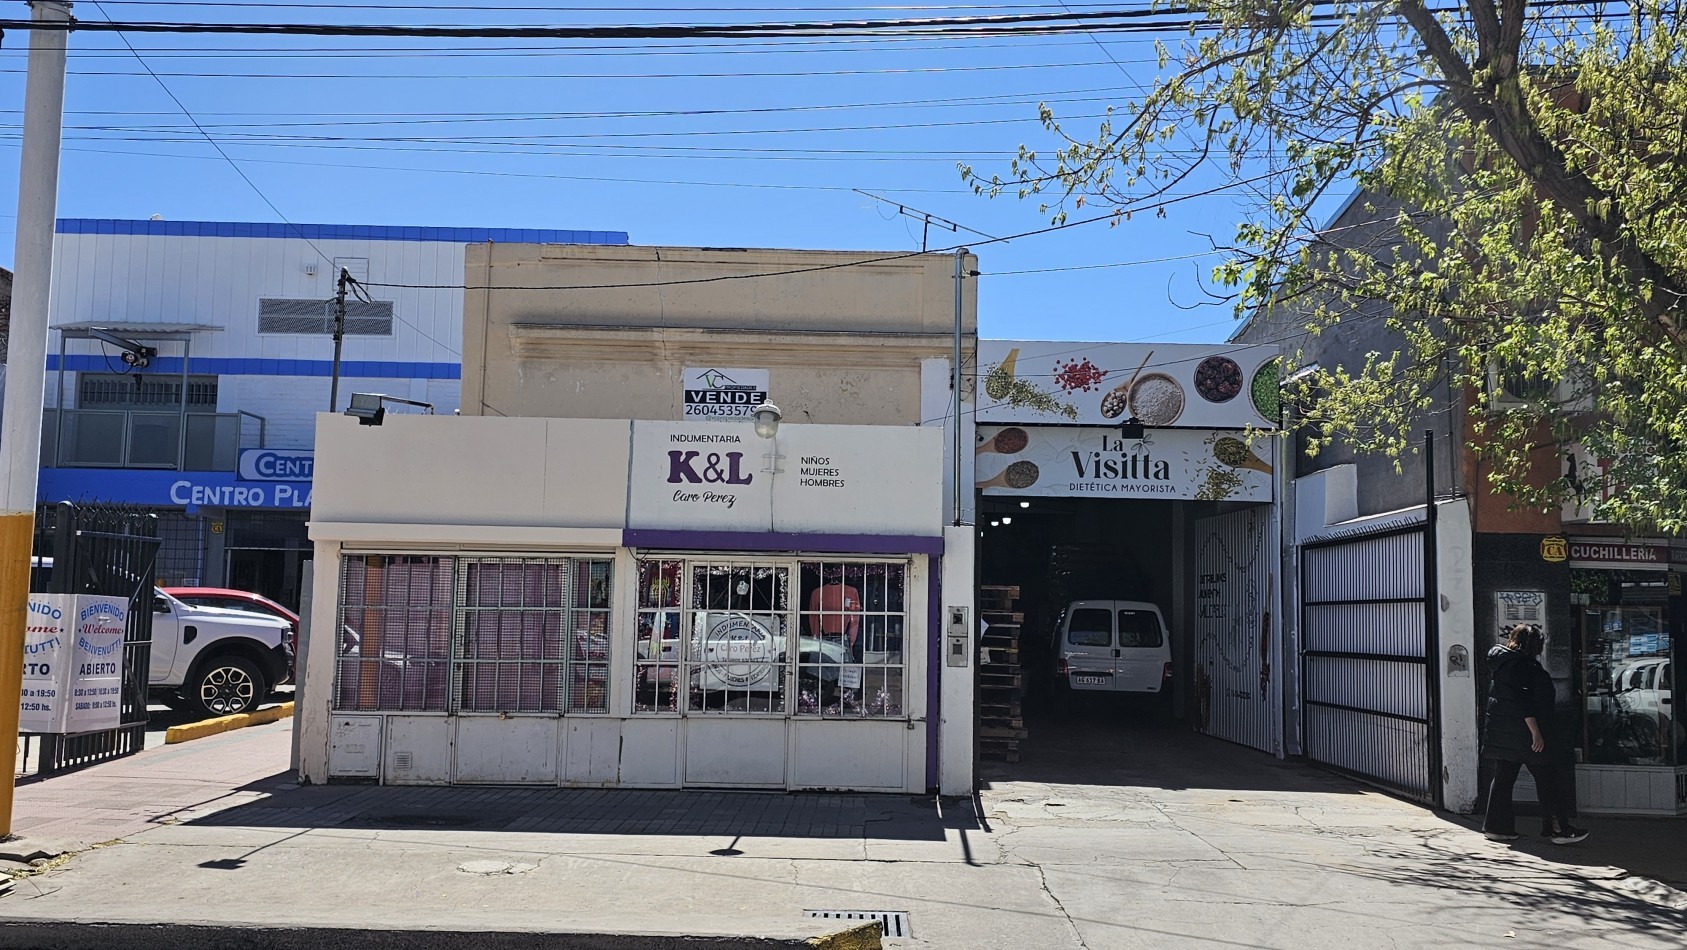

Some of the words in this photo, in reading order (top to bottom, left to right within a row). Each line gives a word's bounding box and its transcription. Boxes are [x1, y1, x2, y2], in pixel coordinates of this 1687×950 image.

[691, 391, 761, 404] VENDE
[685, 405, 758, 417] 260453579
[670, 434, 741, 444] INDUMENTARIA
[1102, 435, 1123, 452] La
[801, 455, 830, 465] NIÑOS
[1070, 451, 1170, 480] Visitta
[666, 450, 753, 486] K&L
[800, 467, 839, 477] MUJERES
[800, 478, 845, 488] HOMBRES
[1069, 482, 1118, 492] DIETÉTICA
[1121, 483, 1176, 493] MAYORISTA
[170, 480, 265, 507] CENTRO
[672, 490, 700, 503] Caro
[702, 491, 737, 508] Perez
[80, 603, 125, 622] BIENVENIDO
[82, 624, 121, 635] Welcome
[715, 620, 767, 640] INDUMENARIA
[79, 637, 121, 655] BENVENUTTI
[720, 644, 738, 652] Cro
[79, 663, 116, 676] ABIERTO
[37, 689, 56, 698] 19:50
[41, 703, 51, 711] hs.
